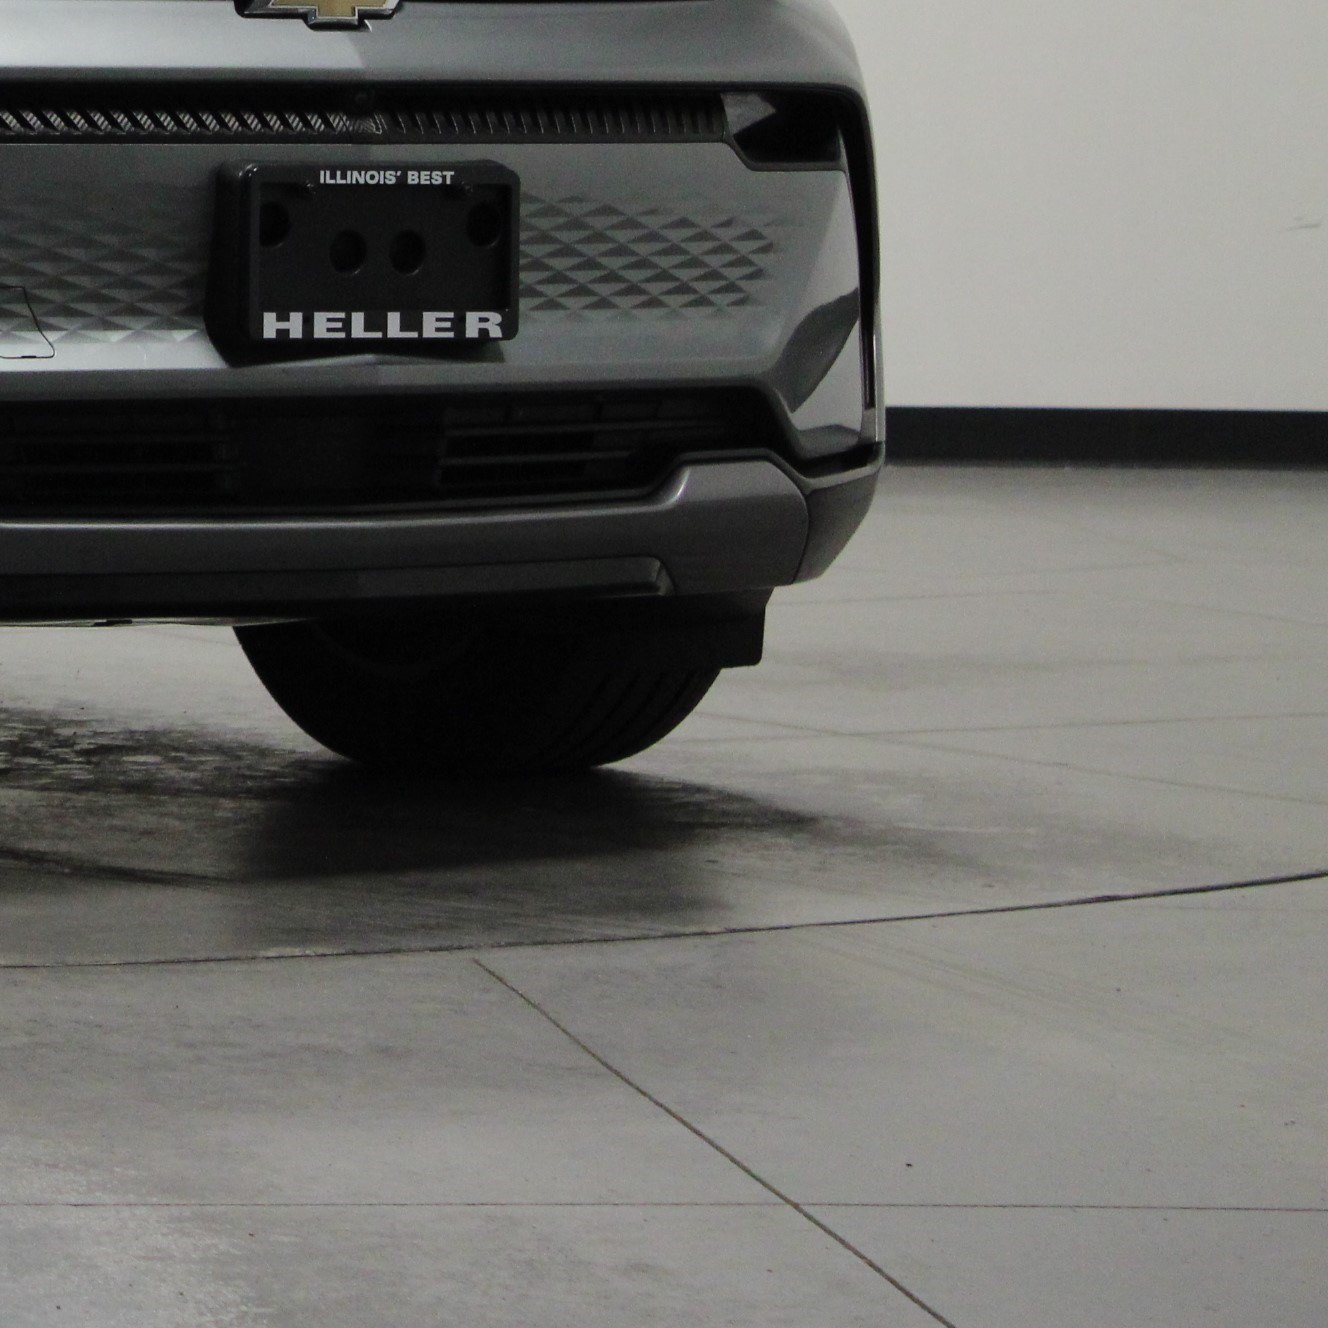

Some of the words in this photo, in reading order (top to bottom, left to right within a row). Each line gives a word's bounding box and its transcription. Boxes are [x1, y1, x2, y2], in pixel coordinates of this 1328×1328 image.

[319, 170, 402, 185] ILLINOIS'
[407, 171, 455, 185] BEST
[263, 311, 503, 339] HELLER
